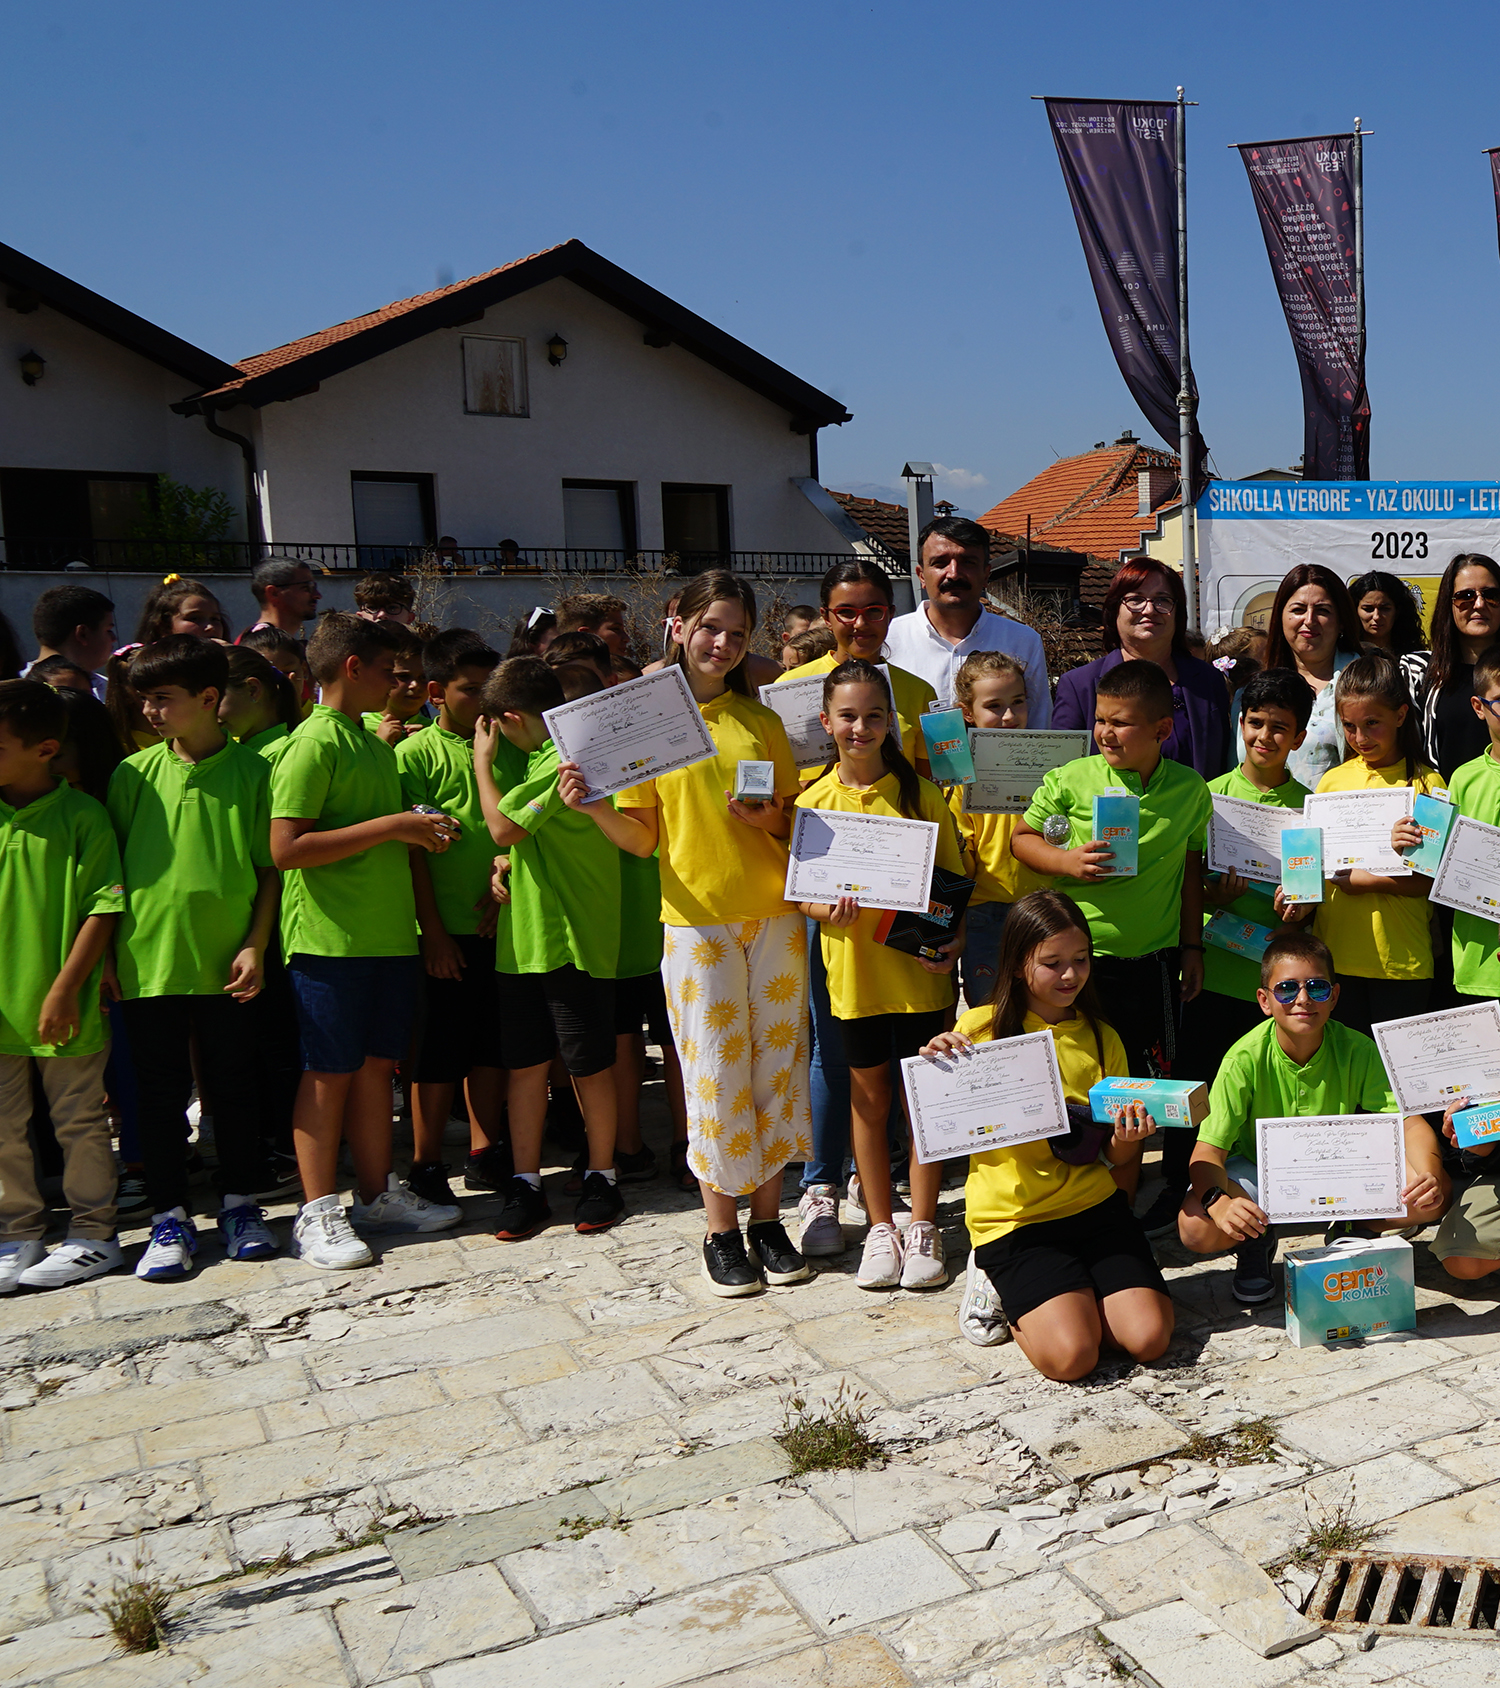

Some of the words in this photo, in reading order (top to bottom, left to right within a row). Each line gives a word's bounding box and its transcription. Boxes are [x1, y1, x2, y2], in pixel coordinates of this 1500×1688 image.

[1209, 488, 1283, 512] SHKOLLA
[1288, 489, 1350, 512] VERORE
[1366, 489, 1398, 511] YAZ
[1402, 489, 1454, 511] OKULU
[1371, 532, 1428, 559] 2023
[1102, 1096, 1133, 1105] KOMEK
[1467, 1110, 1500, 1124] KOMEK
[1342, 1284, 1390, 1302] KOMEK
